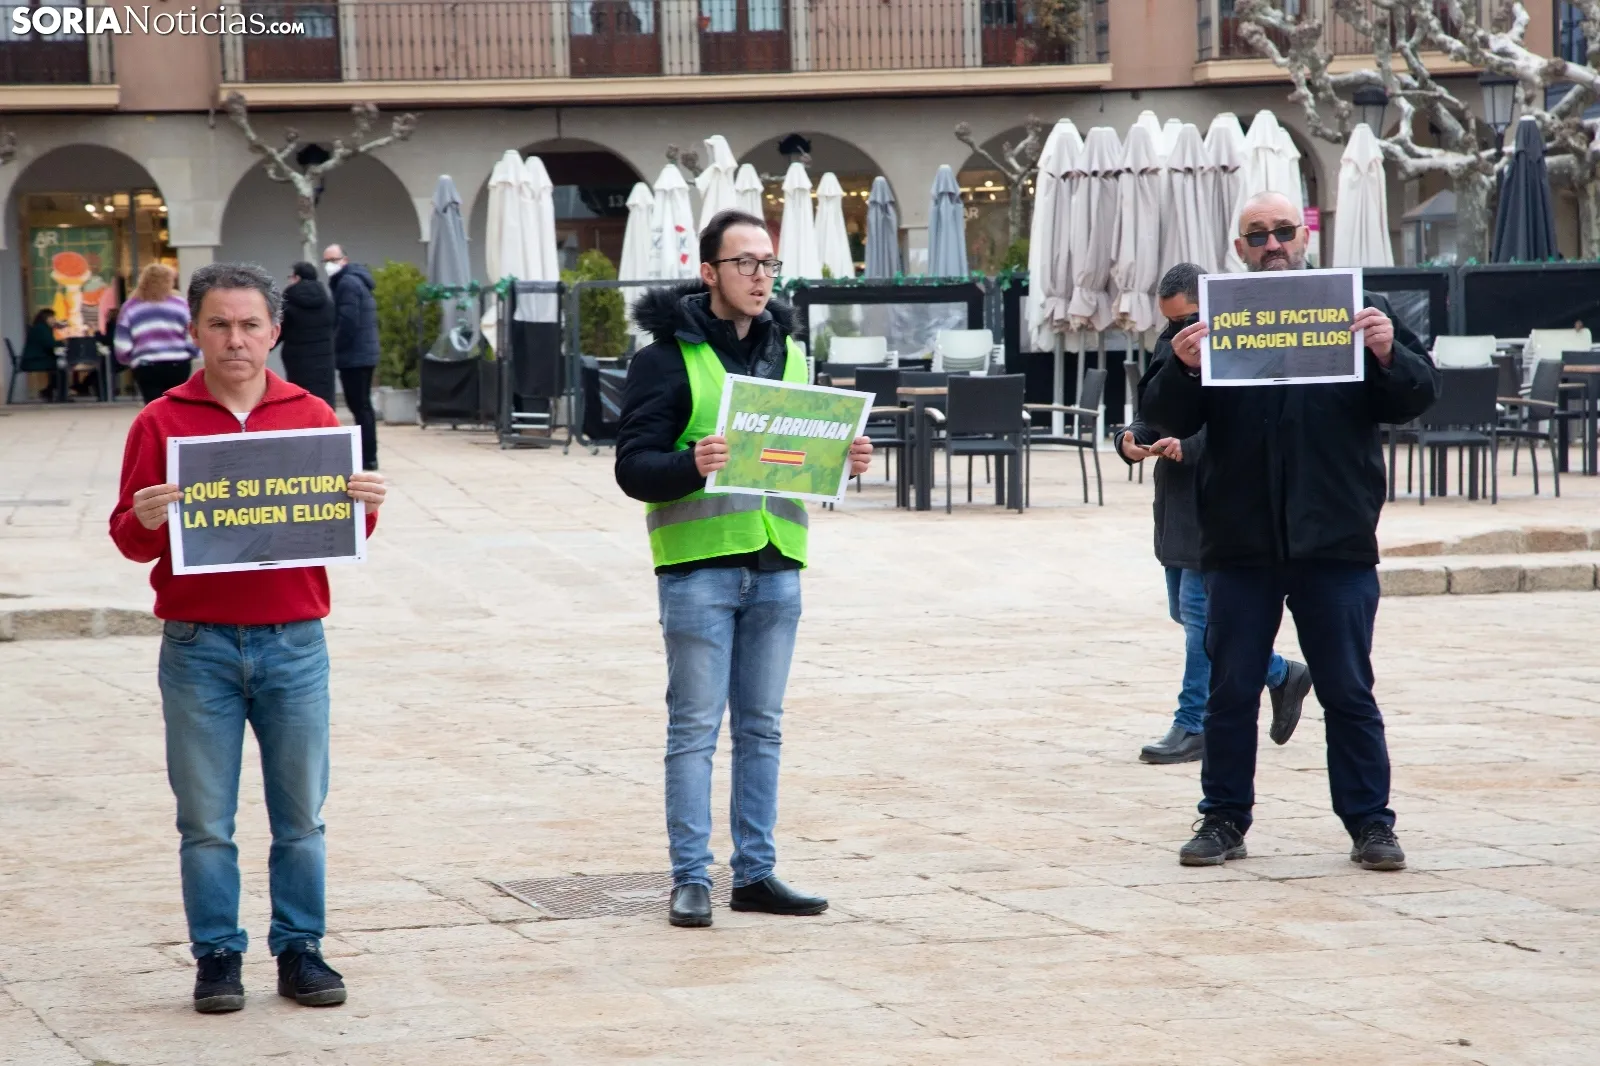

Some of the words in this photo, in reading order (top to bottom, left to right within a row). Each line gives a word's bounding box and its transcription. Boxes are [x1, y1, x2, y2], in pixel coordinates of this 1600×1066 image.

[1213, 308, 1252, 331] ¡QUÉ
[1256, 310, 1276, 326] SU
[1280, 307, 1349, 325] FACTURA
[1212, 334, 1232, 350] LA
[1236, 332, 1298, 349] PAGUEN
[1302, 330, 1352, 347] ELLOS!
[731, 411, 770, 433] NOS
[767, 415, 853, 441] ARRUINAN
[183, 478, 231, 505] ¡QUÉ
[236, 479, 261, 498] SU
[265, 474, 347, 496] FACTURA
[184, 510, 208, 529] LA
[213, 505, 288, 527] PAGUEN
[293, 502, 351, 523] ELLOS!
